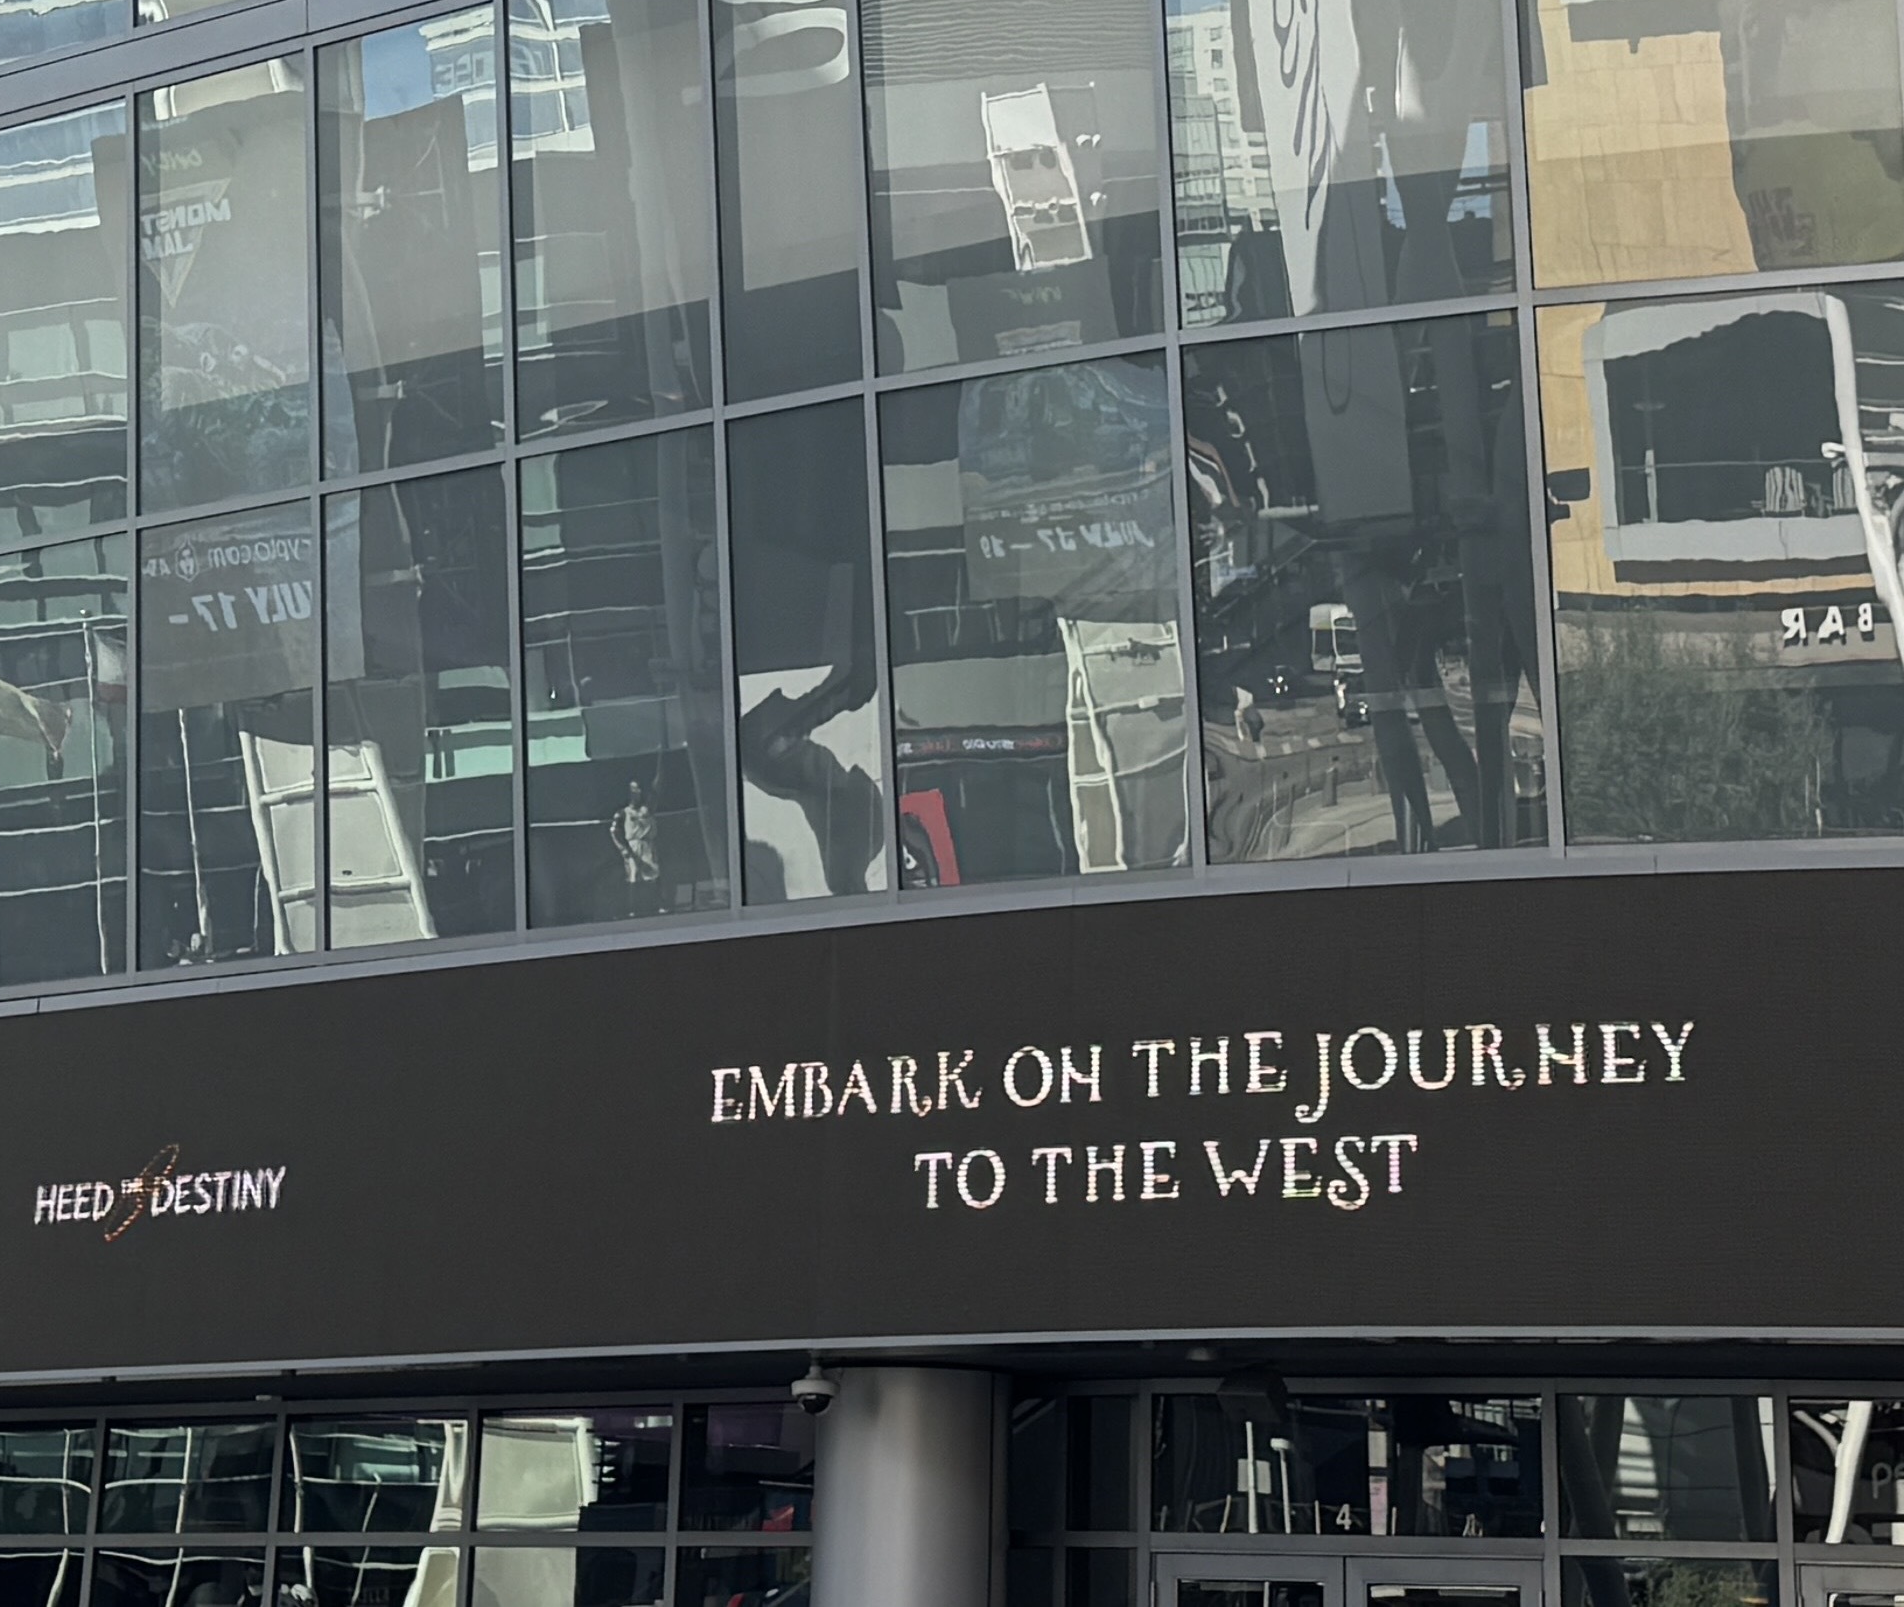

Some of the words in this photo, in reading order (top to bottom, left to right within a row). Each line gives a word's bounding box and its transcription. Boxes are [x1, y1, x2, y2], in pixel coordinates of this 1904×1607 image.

[708, 1048, 984, 1124] EMBARK
[1003, 1044, 1103, 1108] ON
[1132, 1031, 1288, 1098] THE
[1294, 1020, 1695, 1124] JOURNEY
[34, 1181, 114, 1225] HEED
[151, 1166, 286, 1217] DESTINY
[914, 1148, 1007, 1209] TO
[1031, 1140, 1180, 1205] THE
[1203, 1133, 1419, 1211] WEST
[1336, 1504, 1352, 1530] 4
